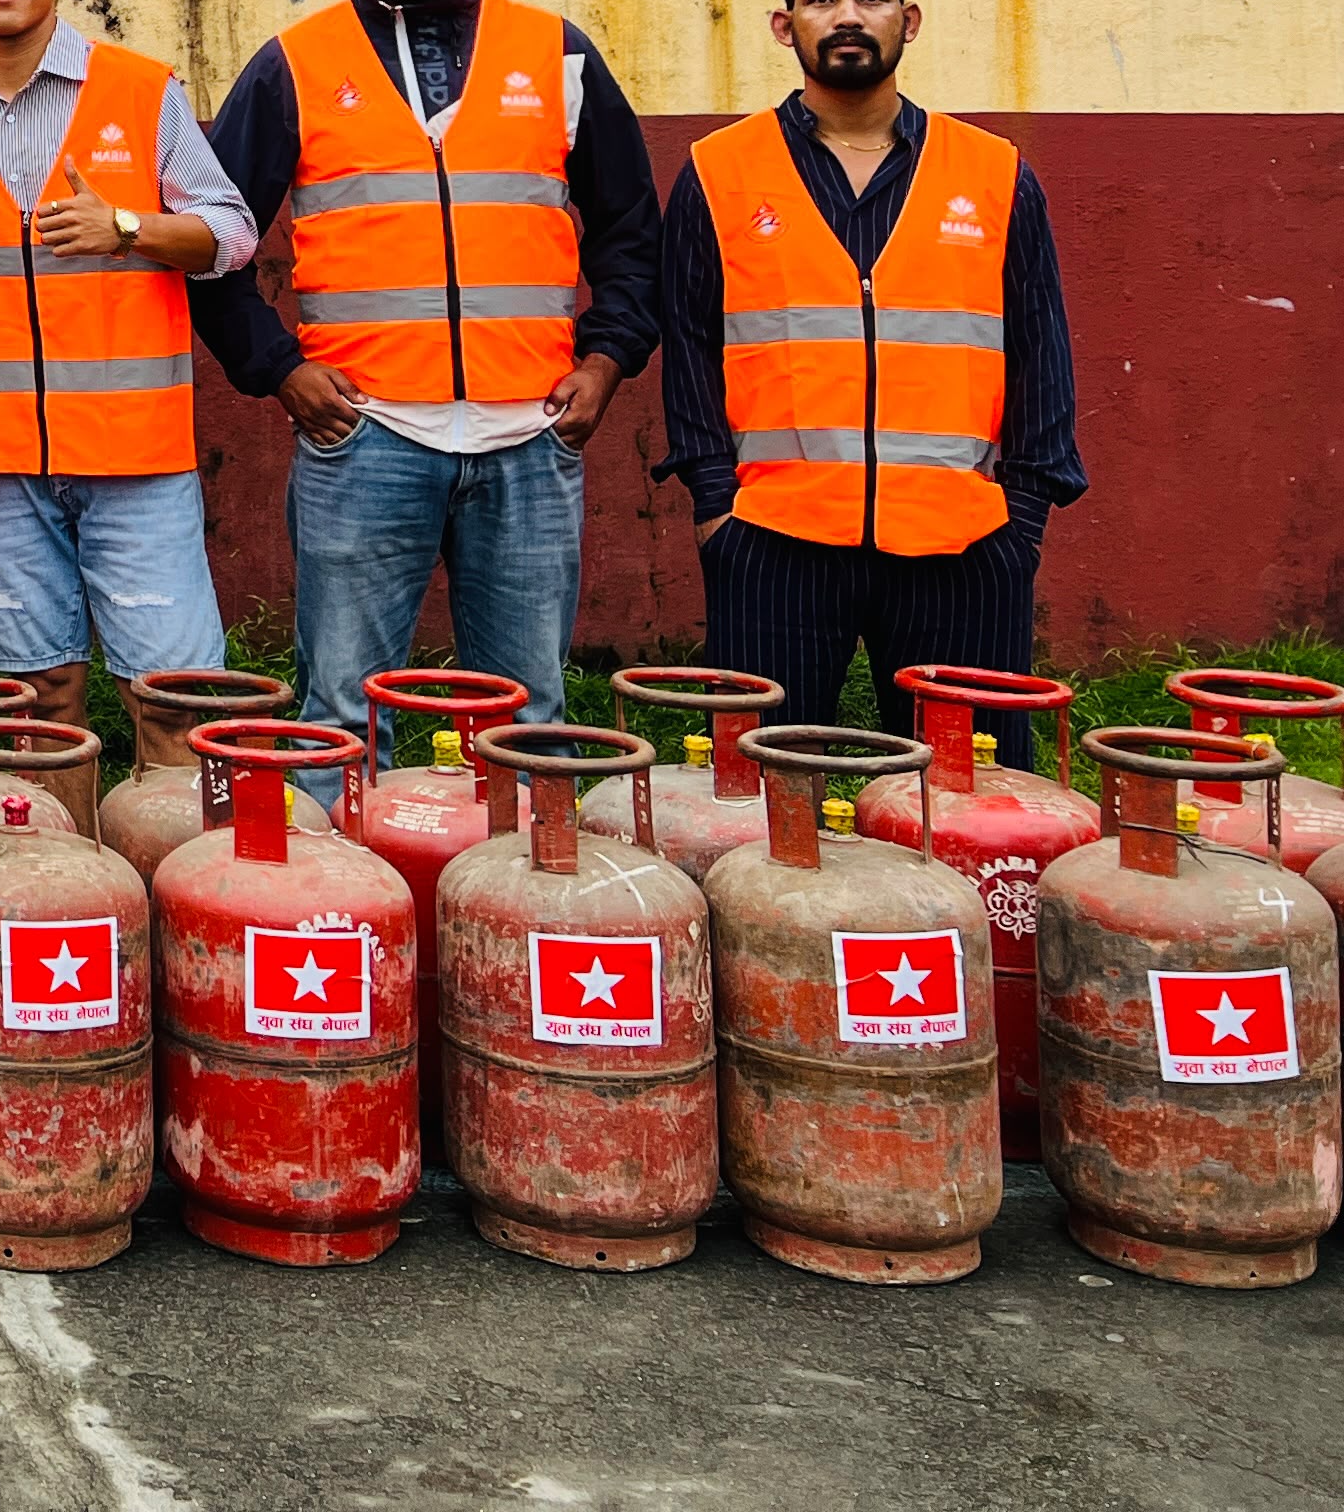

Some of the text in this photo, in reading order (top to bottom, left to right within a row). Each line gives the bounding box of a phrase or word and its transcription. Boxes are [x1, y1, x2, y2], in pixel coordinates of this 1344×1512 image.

[500, 94, 544, 109] MARIA
[91, 149, 132, 164] MARIA
[940, 220, 985, 238] MARIA
[1258, 887, 1295, 929] 4
[15, 1005, 110, 1025] युवा संघ नेपाल
[257, 1015, 360, 1031] युवा संघ नेपाल
[545, 1021, 651, 1038] युवा संघ नेपाल
[852, 1018, 957, 1038] युवा संघ नेपाल
[1174, 1058, 1288, 1078] युवा संघ नेपाल
